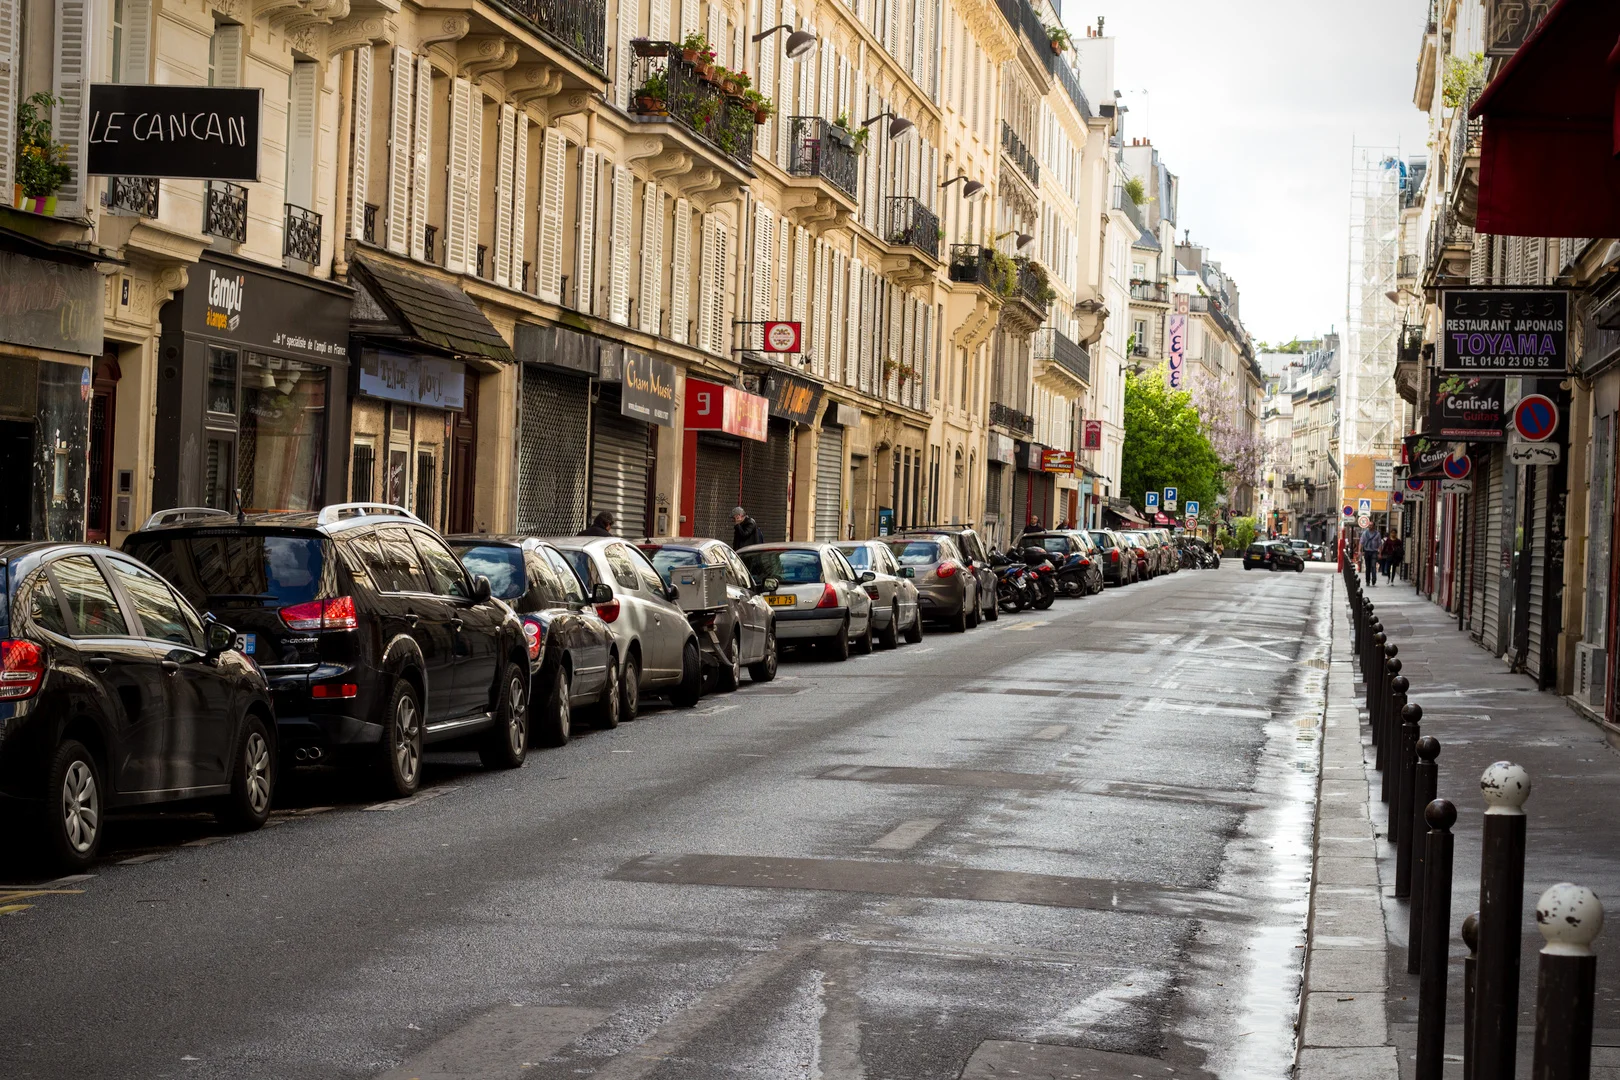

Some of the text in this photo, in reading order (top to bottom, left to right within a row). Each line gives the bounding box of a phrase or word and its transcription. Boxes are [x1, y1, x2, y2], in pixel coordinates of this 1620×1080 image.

[89, 110, 246, 147] LE CANCAN
[1446, 319, 1563, 332] RESTAURANT JAPONAIS
[1452, 333, 1556, 355] TOYAMA
[1459, 356, 1477, 367] TEL
[1508, 356, 1520, 367] 23
[1522, 356, 1535, 367] 09
[1537, 356, 1549, 367] 52
[1446, 395, 1500, 410] Centrale
[1463, 410, 1499, 421] Guitars
[1421, 450, 1448, 463] Centra
[1149, 495, 1156, 504] P
[1167, 490, 1174, 499] P
[880, 516, 887, 525] P
[784, 596, 793, 604] 75
